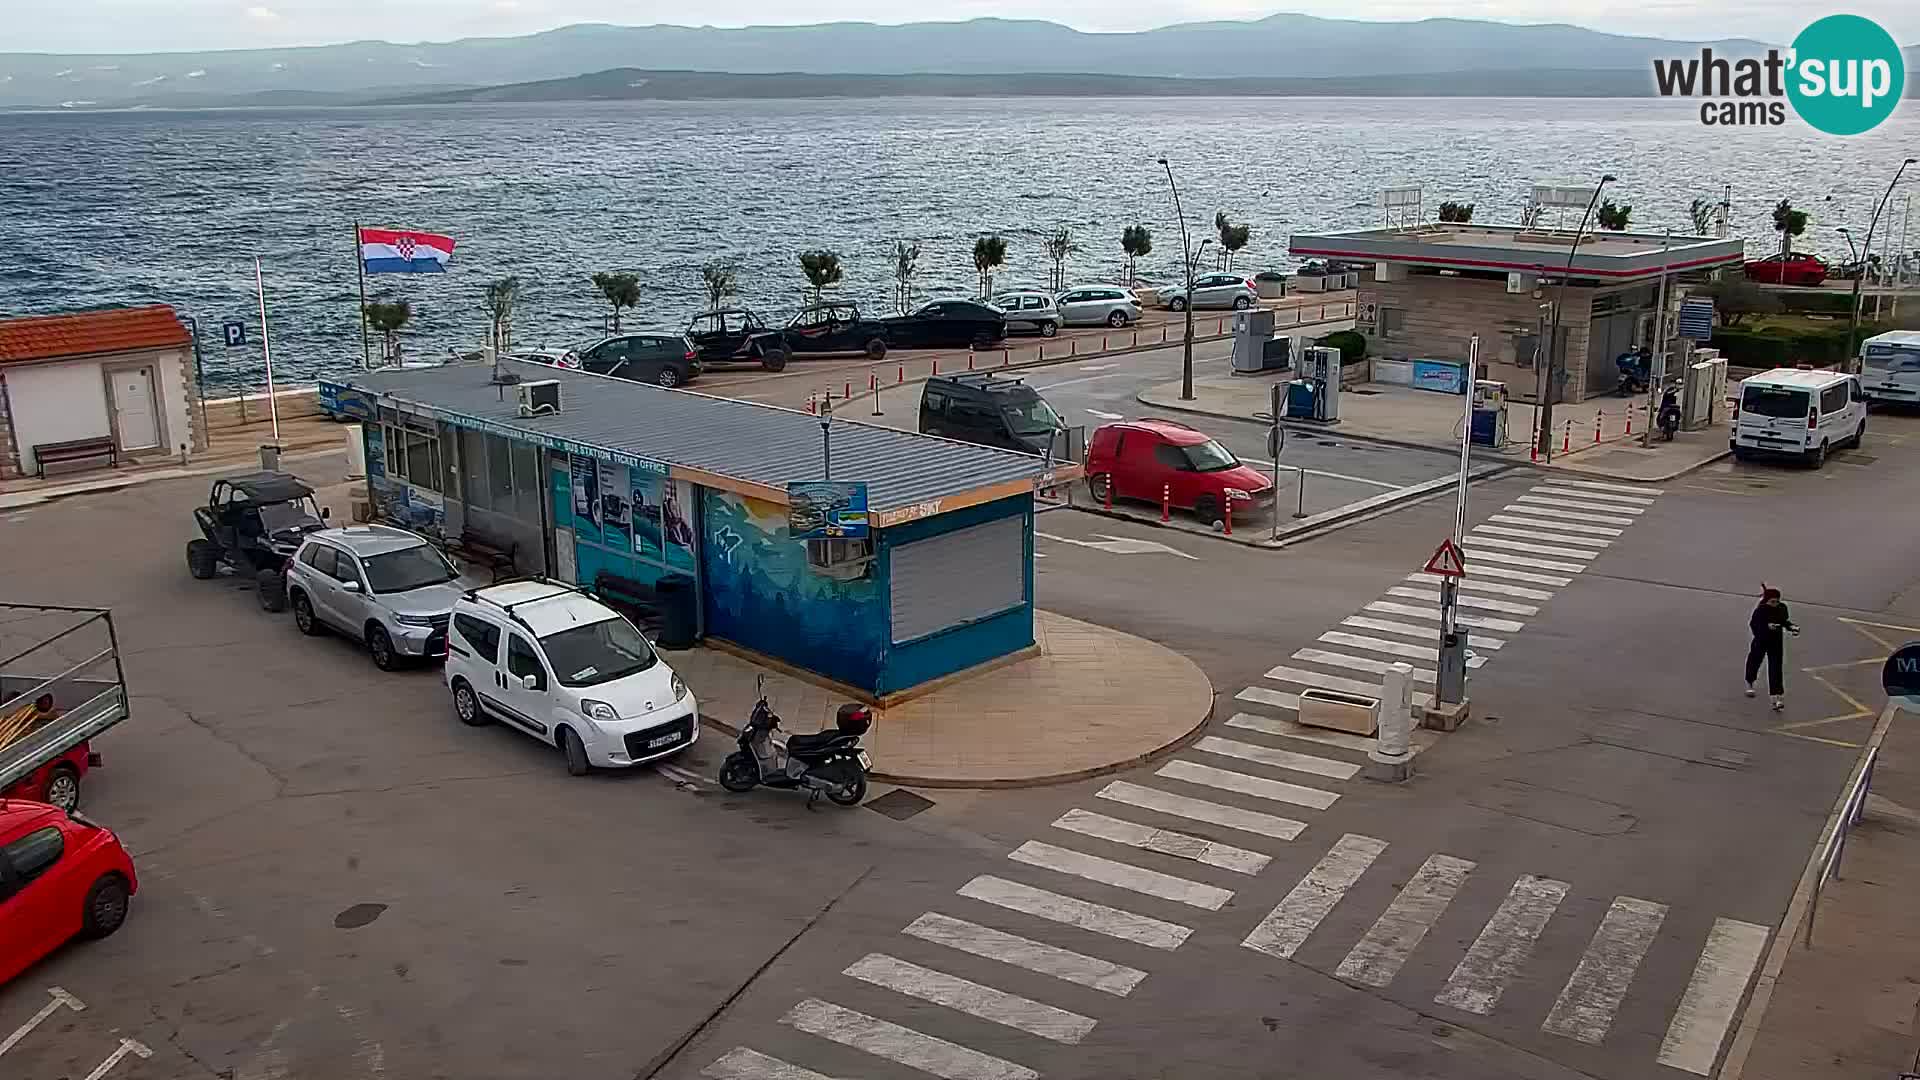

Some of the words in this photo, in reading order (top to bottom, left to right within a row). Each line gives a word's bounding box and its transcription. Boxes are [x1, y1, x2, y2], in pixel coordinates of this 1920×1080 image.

[229, 325, 240, 344] P
[564, 441, 578, 453] BUS
[580, 446, 611, 461] STATION
[614, 454, 638, 467] TICKET
[640, 458, 666, 473] OFFICE
